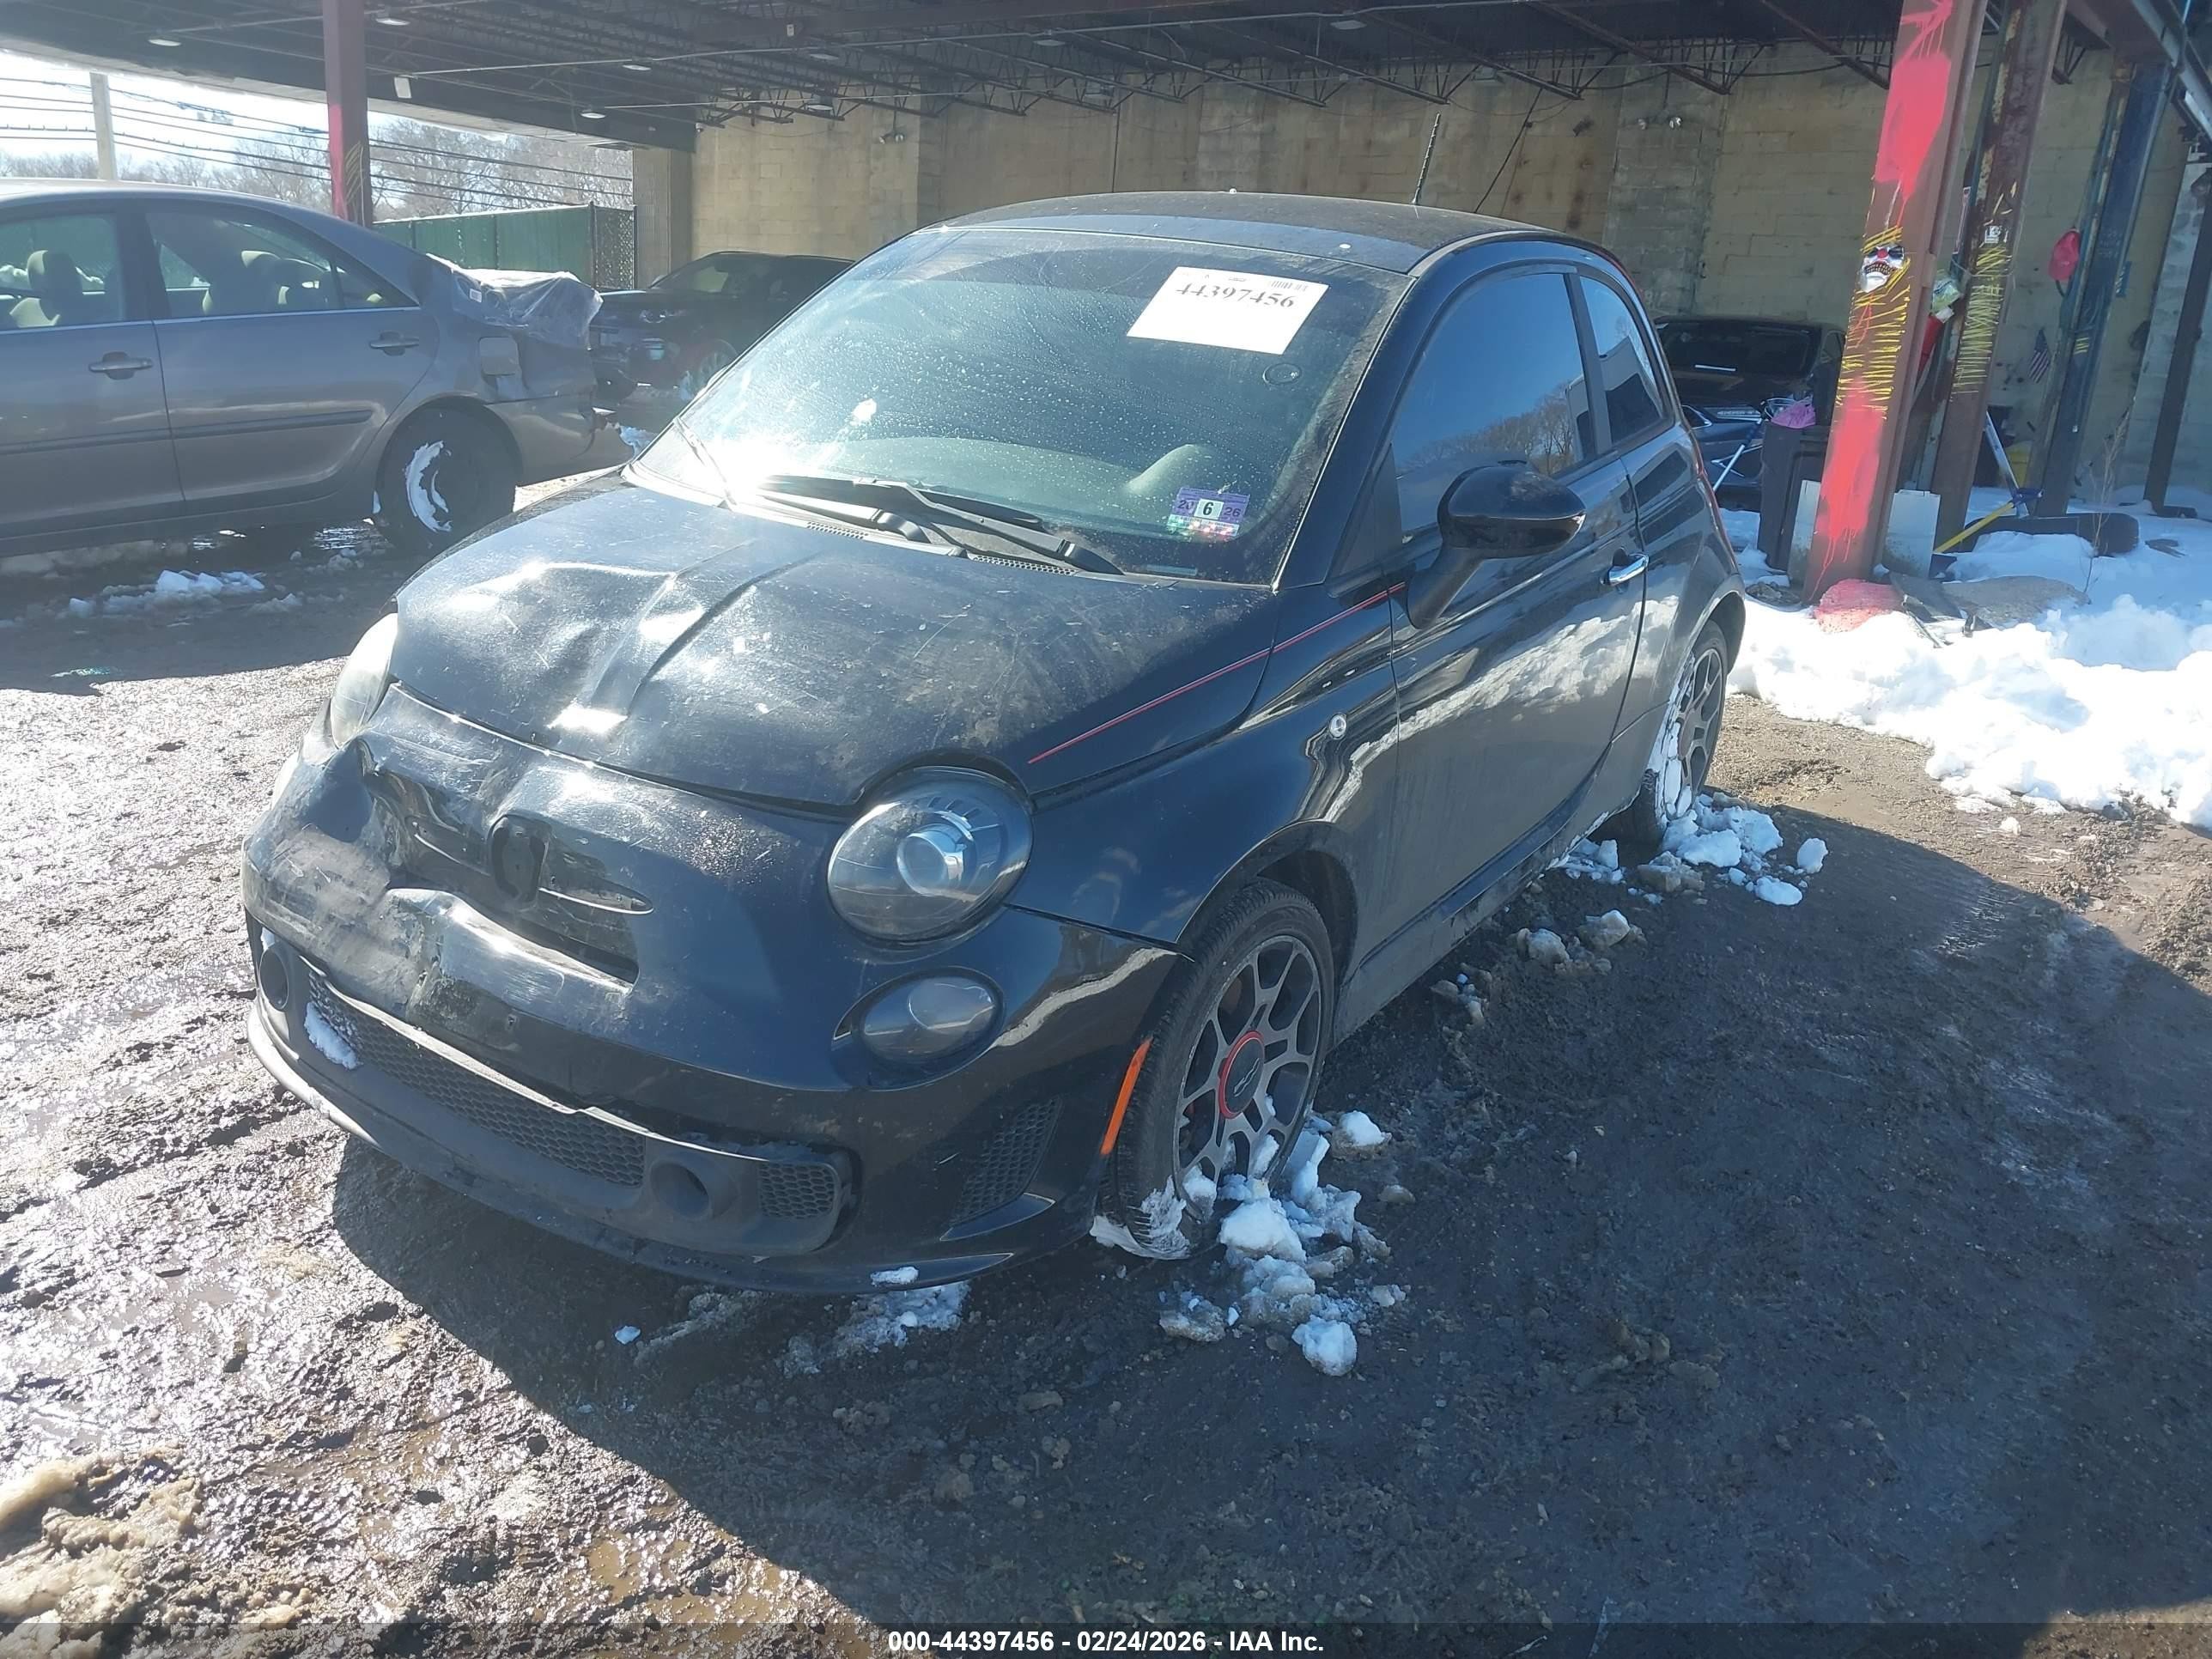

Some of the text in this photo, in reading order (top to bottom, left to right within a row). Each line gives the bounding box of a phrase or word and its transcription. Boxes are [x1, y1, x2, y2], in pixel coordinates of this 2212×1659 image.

[1176, 283, 1296, 307] 44397456
[1202, 501, 1214, 515] 6
[1224, 507, 1242, 517] 26
